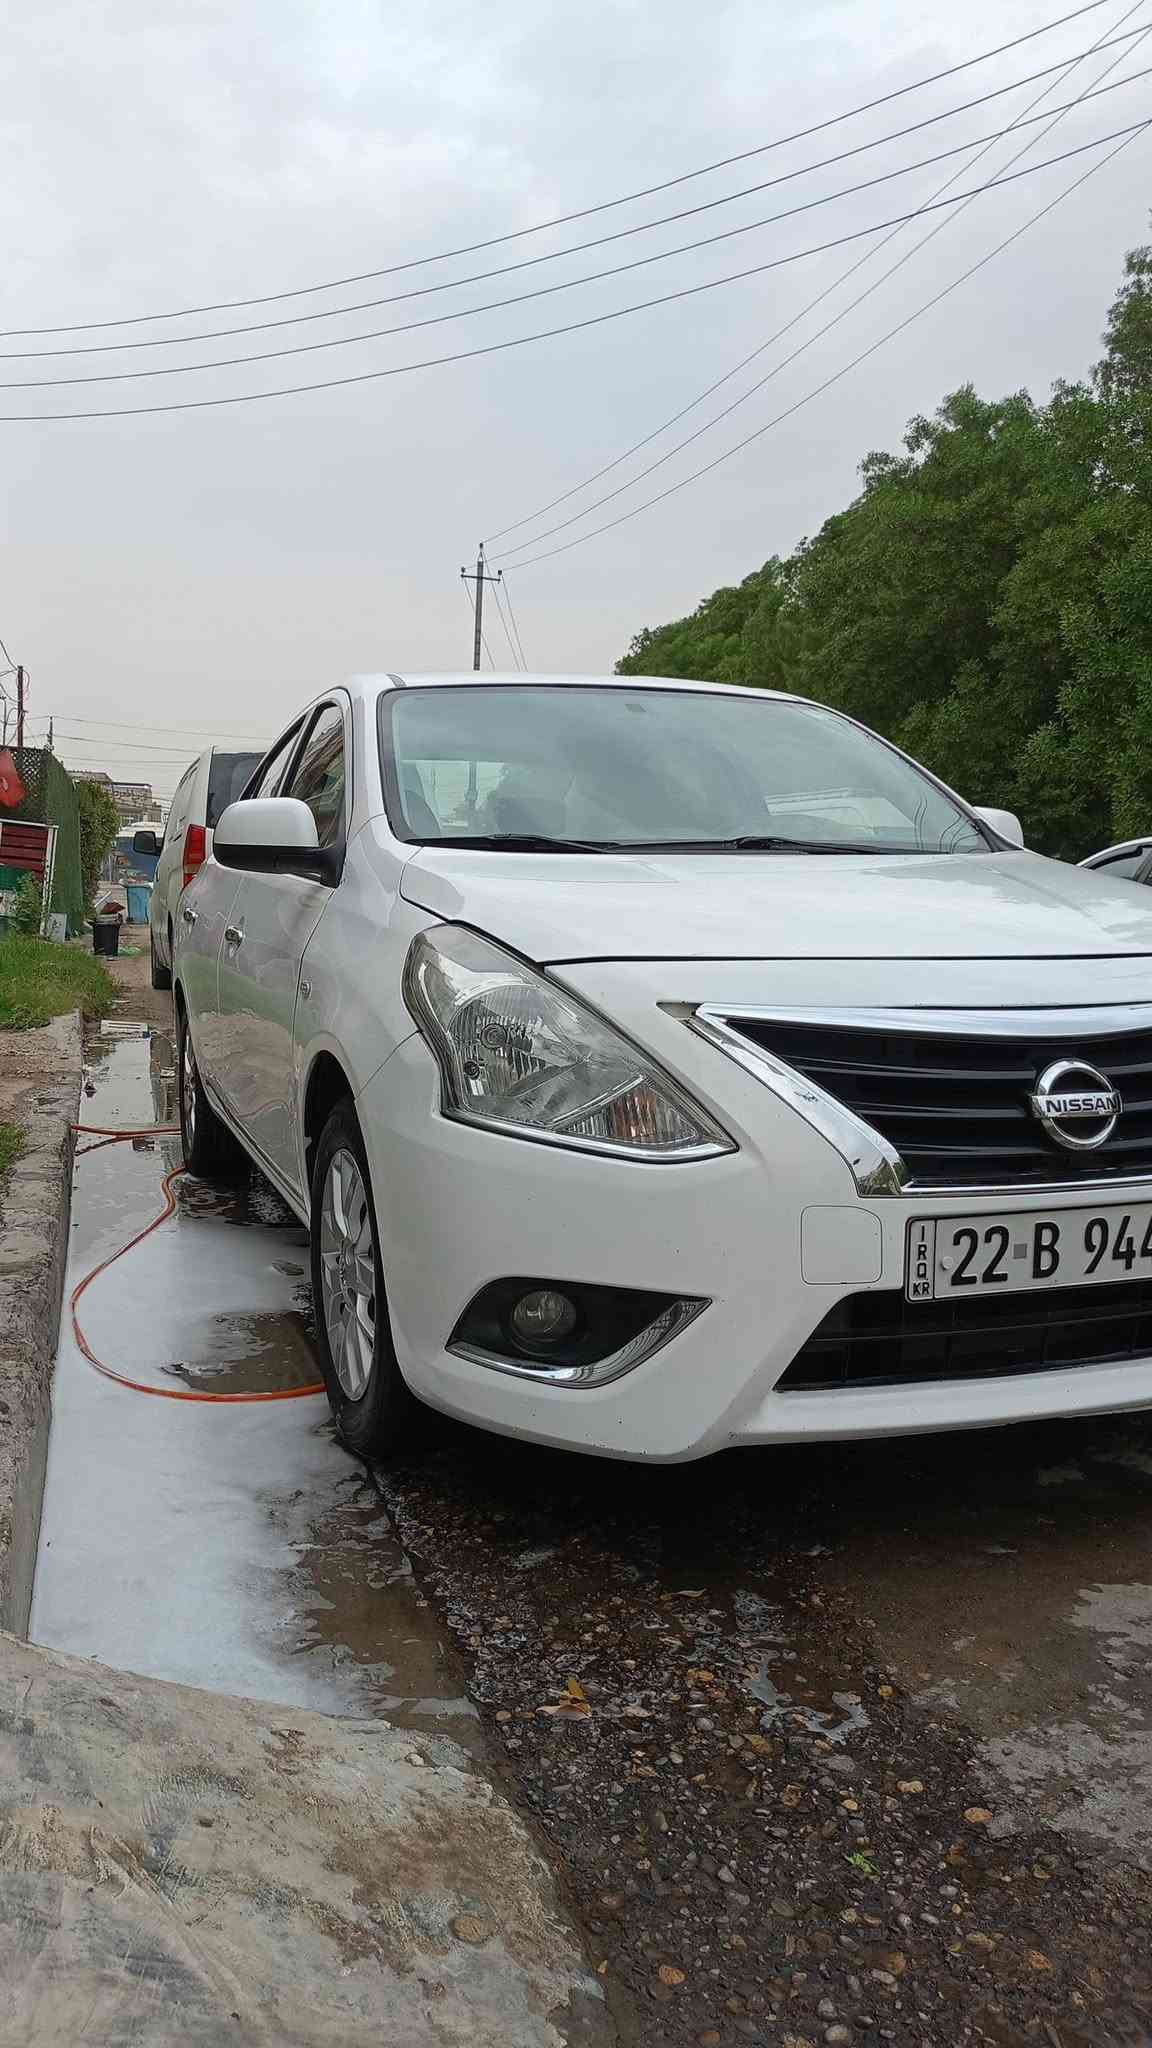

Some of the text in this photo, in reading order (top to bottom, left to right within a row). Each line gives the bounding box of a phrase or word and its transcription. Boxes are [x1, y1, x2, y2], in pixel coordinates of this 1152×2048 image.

[1045, 1096, 1120, 1113] NISSAN
[917, 1225, 927, 1279] IRQ
[951, 1226, 1009, 1286] 22
[1033, 1222, 1060, 1279] B
[913, 1281, 930, 1296] KR
